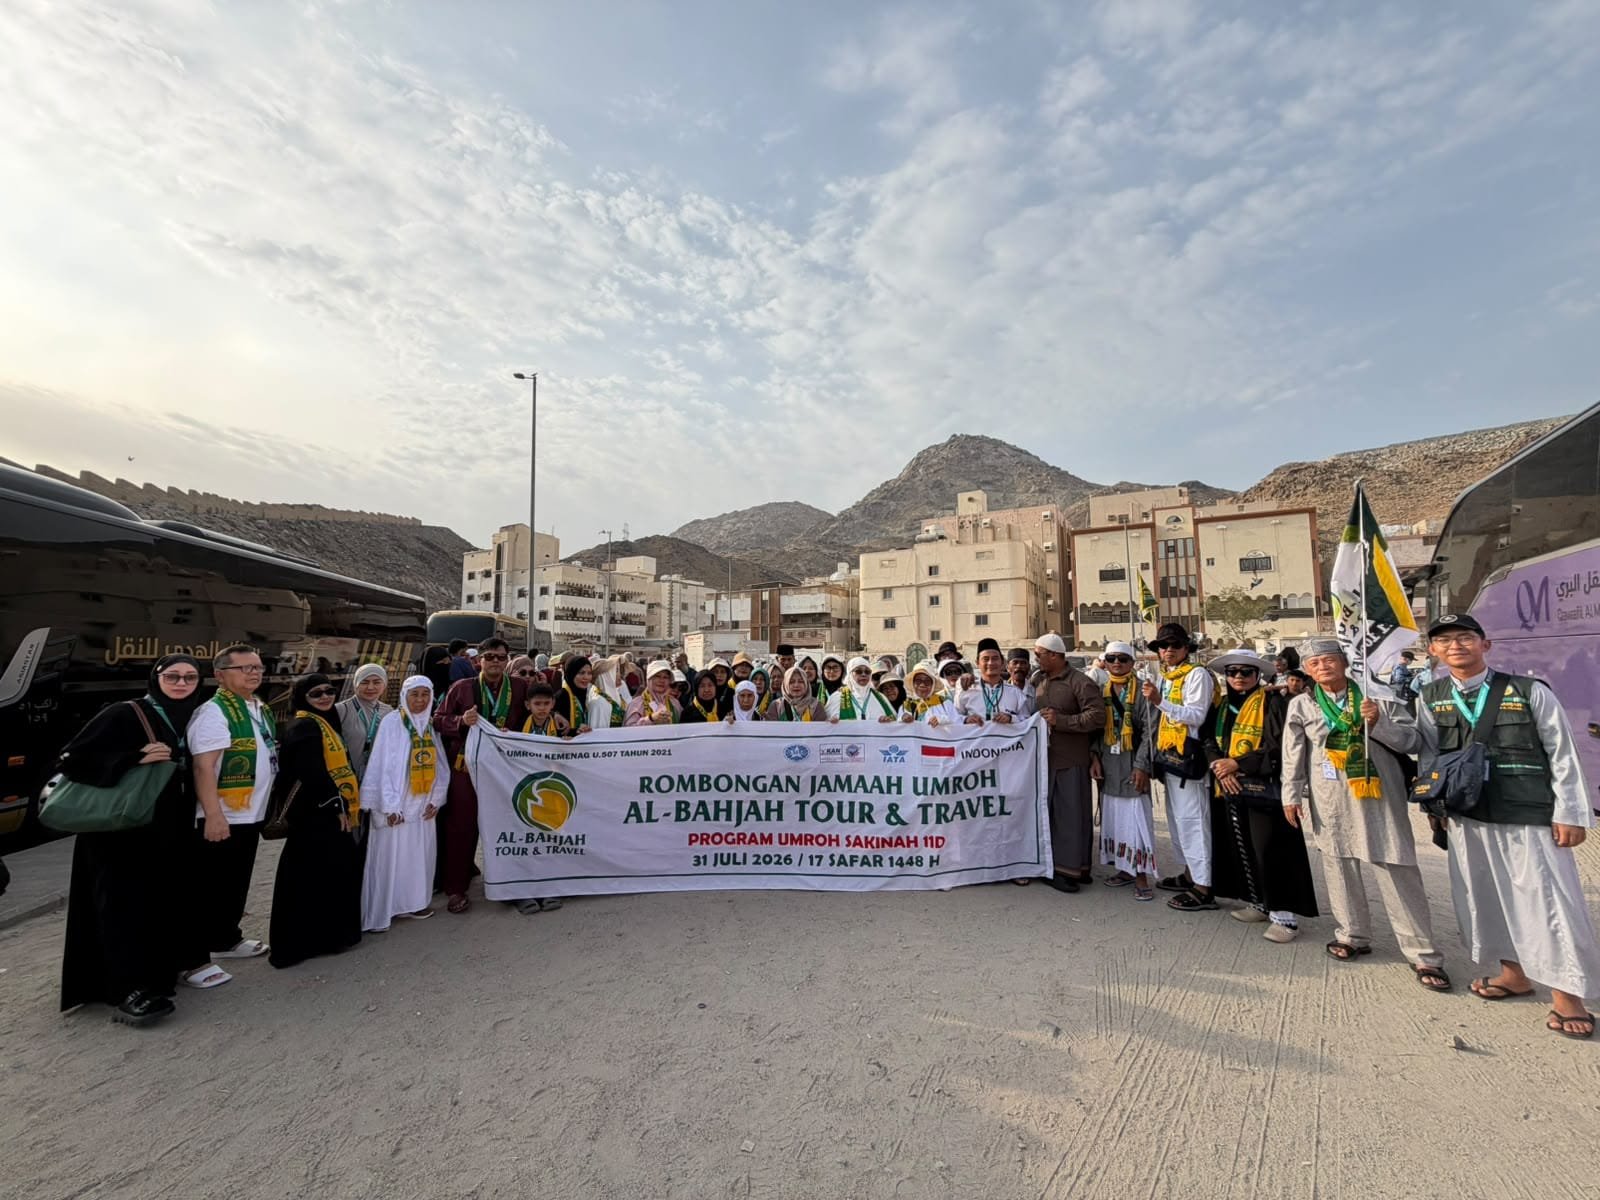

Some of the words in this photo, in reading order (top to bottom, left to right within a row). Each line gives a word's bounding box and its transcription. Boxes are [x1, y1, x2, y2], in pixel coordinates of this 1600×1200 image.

[1556, 573, 1580, 601] البري
[105, 636, 159, 664] للنقل
[545, 751, 590, 760] KEMENAG
[593, 750, 617, 759] U.507
[621, 749, 648, 758] TAHUN
[651, 748, 672, 757] 2021
[883, 756, 905, 764] IATA
[639, 774, 800, 793] ROMBONGAN
[809, 775, 902, 797] JAMAAH
[912, 769, 996, 796] UMROH
[623, 800, 784, 828] AL-BAHJAH
[795, 800, 875, 824] TOUR
[885, 802, 909, 826] &
[917, 794, 1012, 825] TRAVEL
[496, 832, 586, 846] AL-BAHJAH
[688, 832, 774, 846] PROGRAM
[778, 832, 840, 848] UMROH
[845, 834, 919, 850] SAKINAH
[923, 836, 946, 849] 11D
[495, 846, 529, 856] TOUR
[532, 846, 541, 856] &
[546, 845, 586, 856] TRAVEL
[692, 853, 708, 867] 31
[713, 852, 747, 867] JULI
[752, 853, 793, 866] 2026
[798, 853, 804, 867] /
[808, 853, 825, 867] 17
[829, 853, 884, 868] SAFAR
[888, 855, 924, 868] 1448
[929, 854, 941, 868] H
